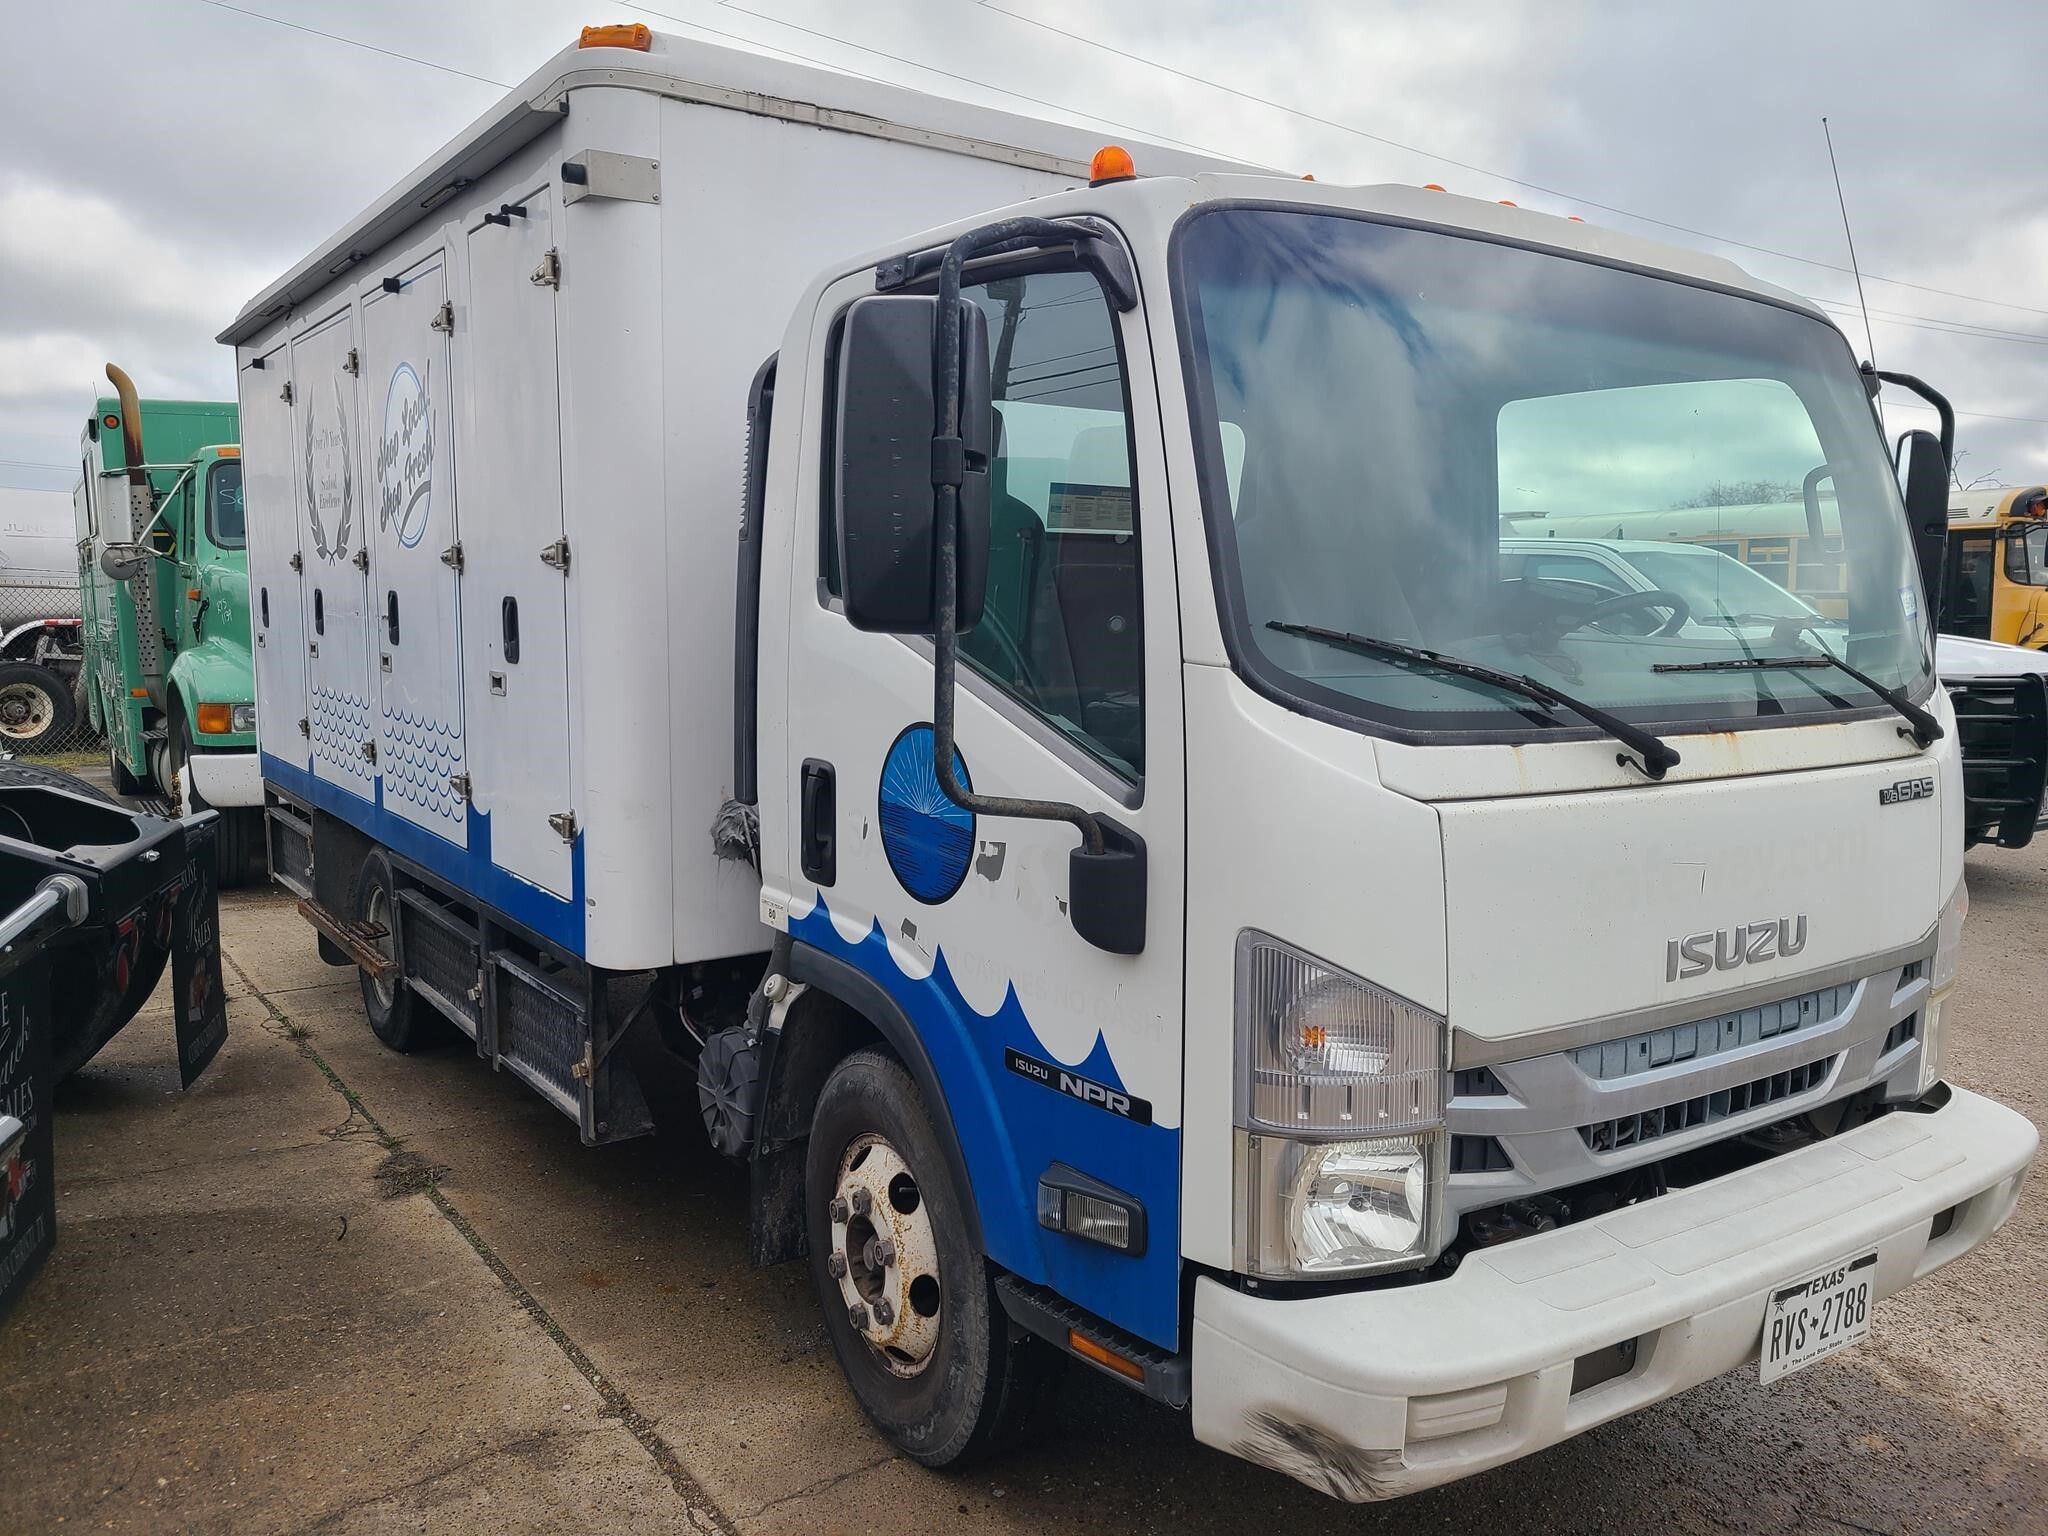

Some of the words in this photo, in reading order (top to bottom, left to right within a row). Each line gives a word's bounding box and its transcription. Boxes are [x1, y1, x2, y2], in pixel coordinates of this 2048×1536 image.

[378, 430, 399, 484] Shop
[401, 358, 431, 448] Local!
[380, 480, 402, 533] Shop
[404, 409, 436, 496] Fresh!
[1897, 778, 1933, 801] GAS
[1666, 913, 1807, 983] ISUZU
[1015, 1058, 1048, 1080] ISUZU
[1060, 1073, 1130, 1117] NPR
[1803, 1267, 1845, 1298] TEXAS
[1769, 1307, 1808, 1363] RVS
[1819, 1282, 1867, 1341] 2788
[1791, 1357, 1802, 1366] The
[1803, 1351, 1816, 1361] Lone
[1816, 1345, 1828, 1355] Star
[1828, 1339, 1843, 1350] State
